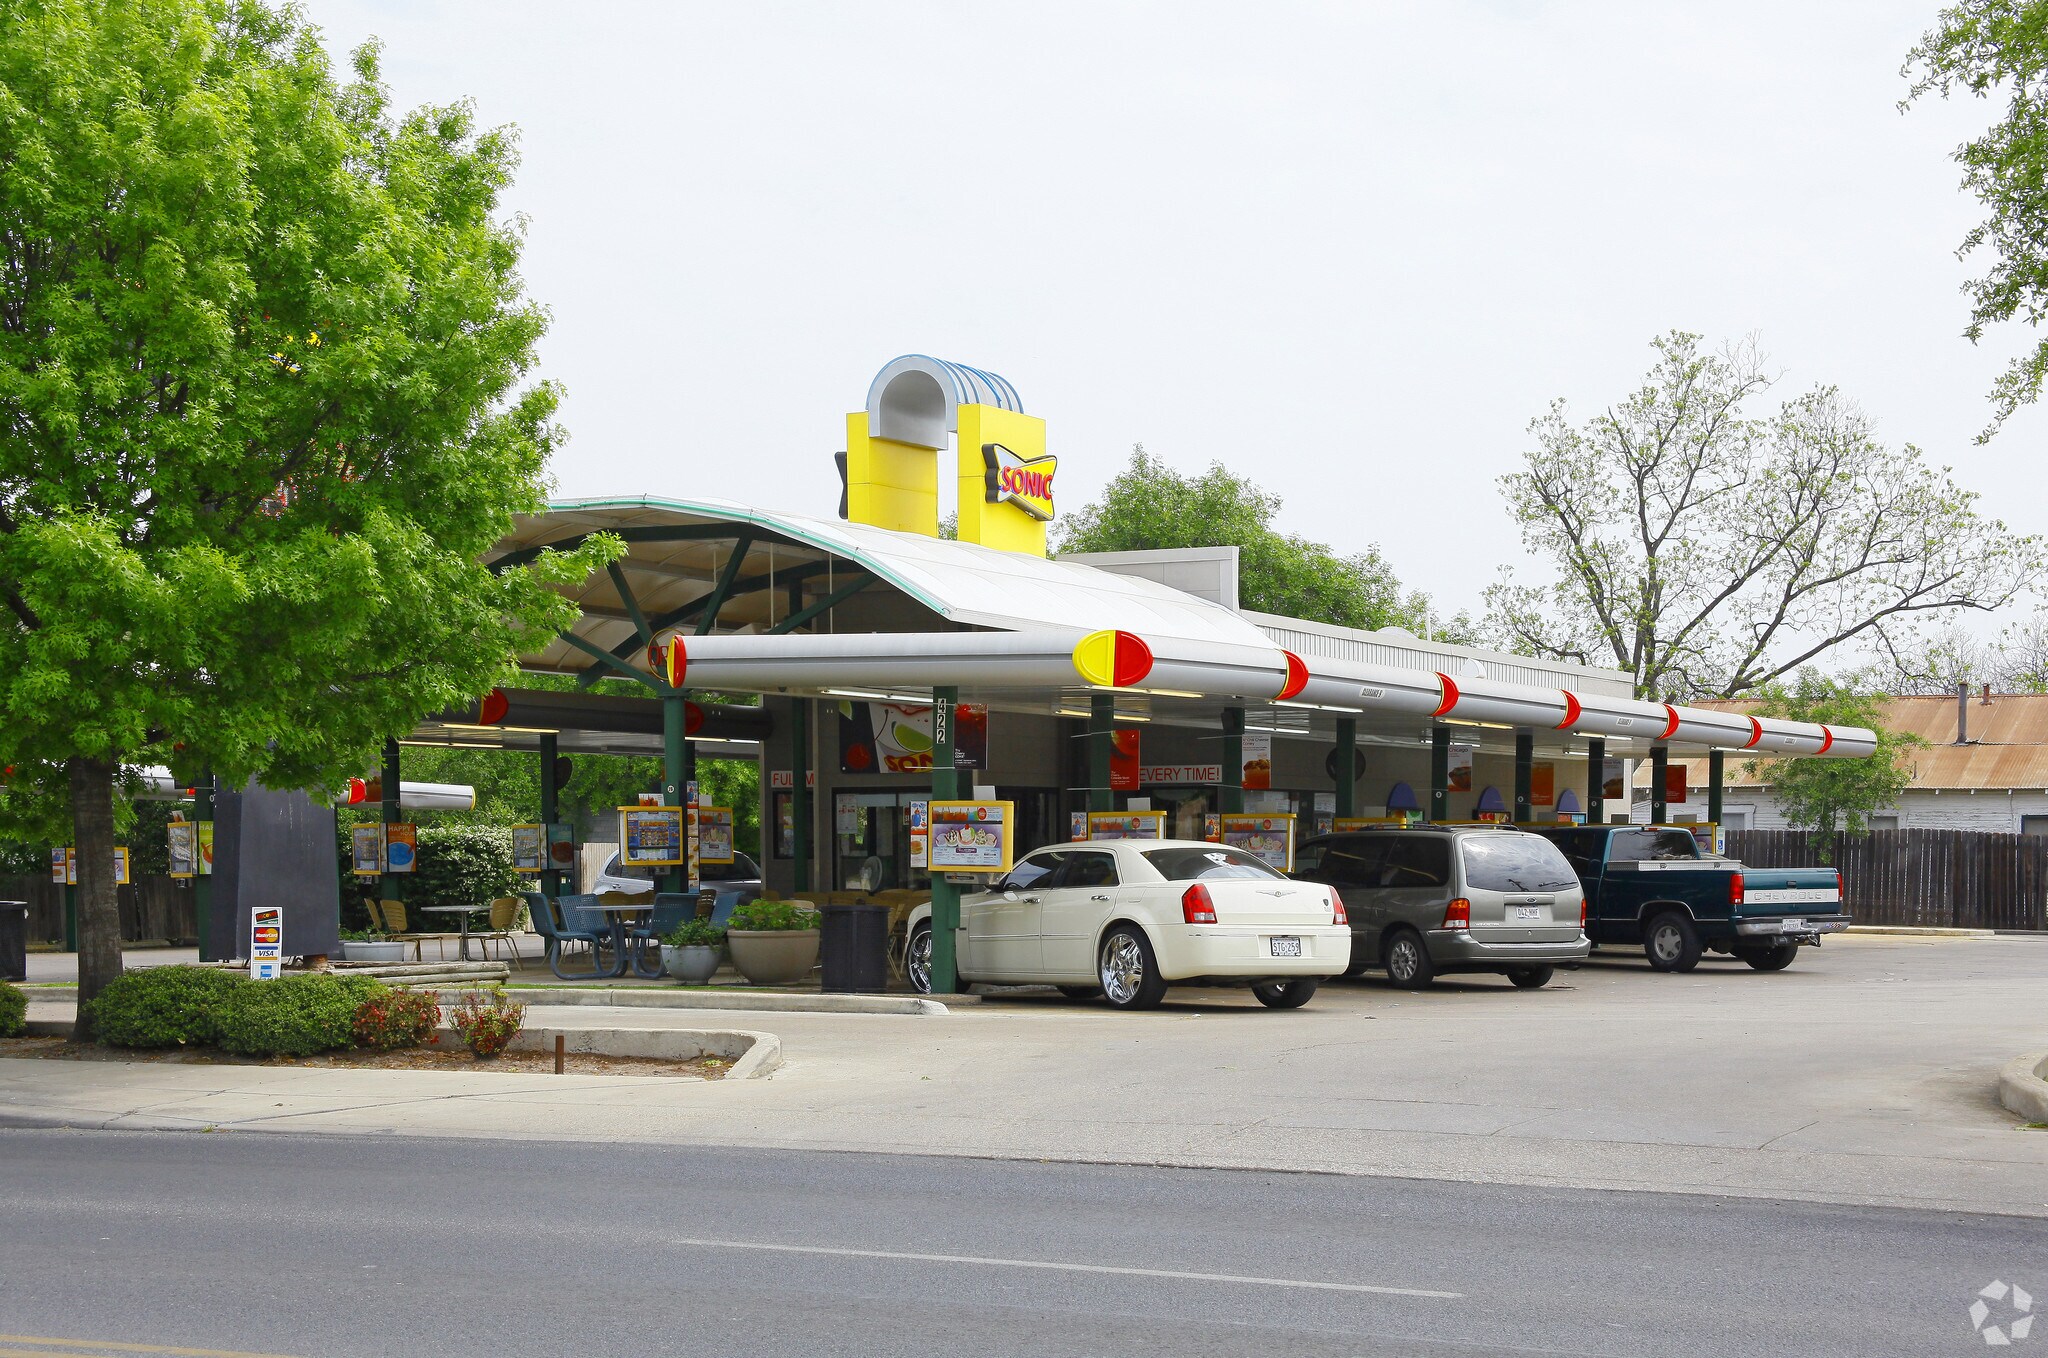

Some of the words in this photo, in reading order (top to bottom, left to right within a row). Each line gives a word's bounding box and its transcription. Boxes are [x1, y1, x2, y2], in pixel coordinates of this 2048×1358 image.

[1001, 465, 1053, 500] SONIC
[884, 754, 933, 773] SON
[773, 773, 793, 786] FUL
[1140, 768, 1181, 782] EVERY
[1184, 767, 1219, 781] TIME!
[1754, 891, 1829, 901] CHEVROLET
